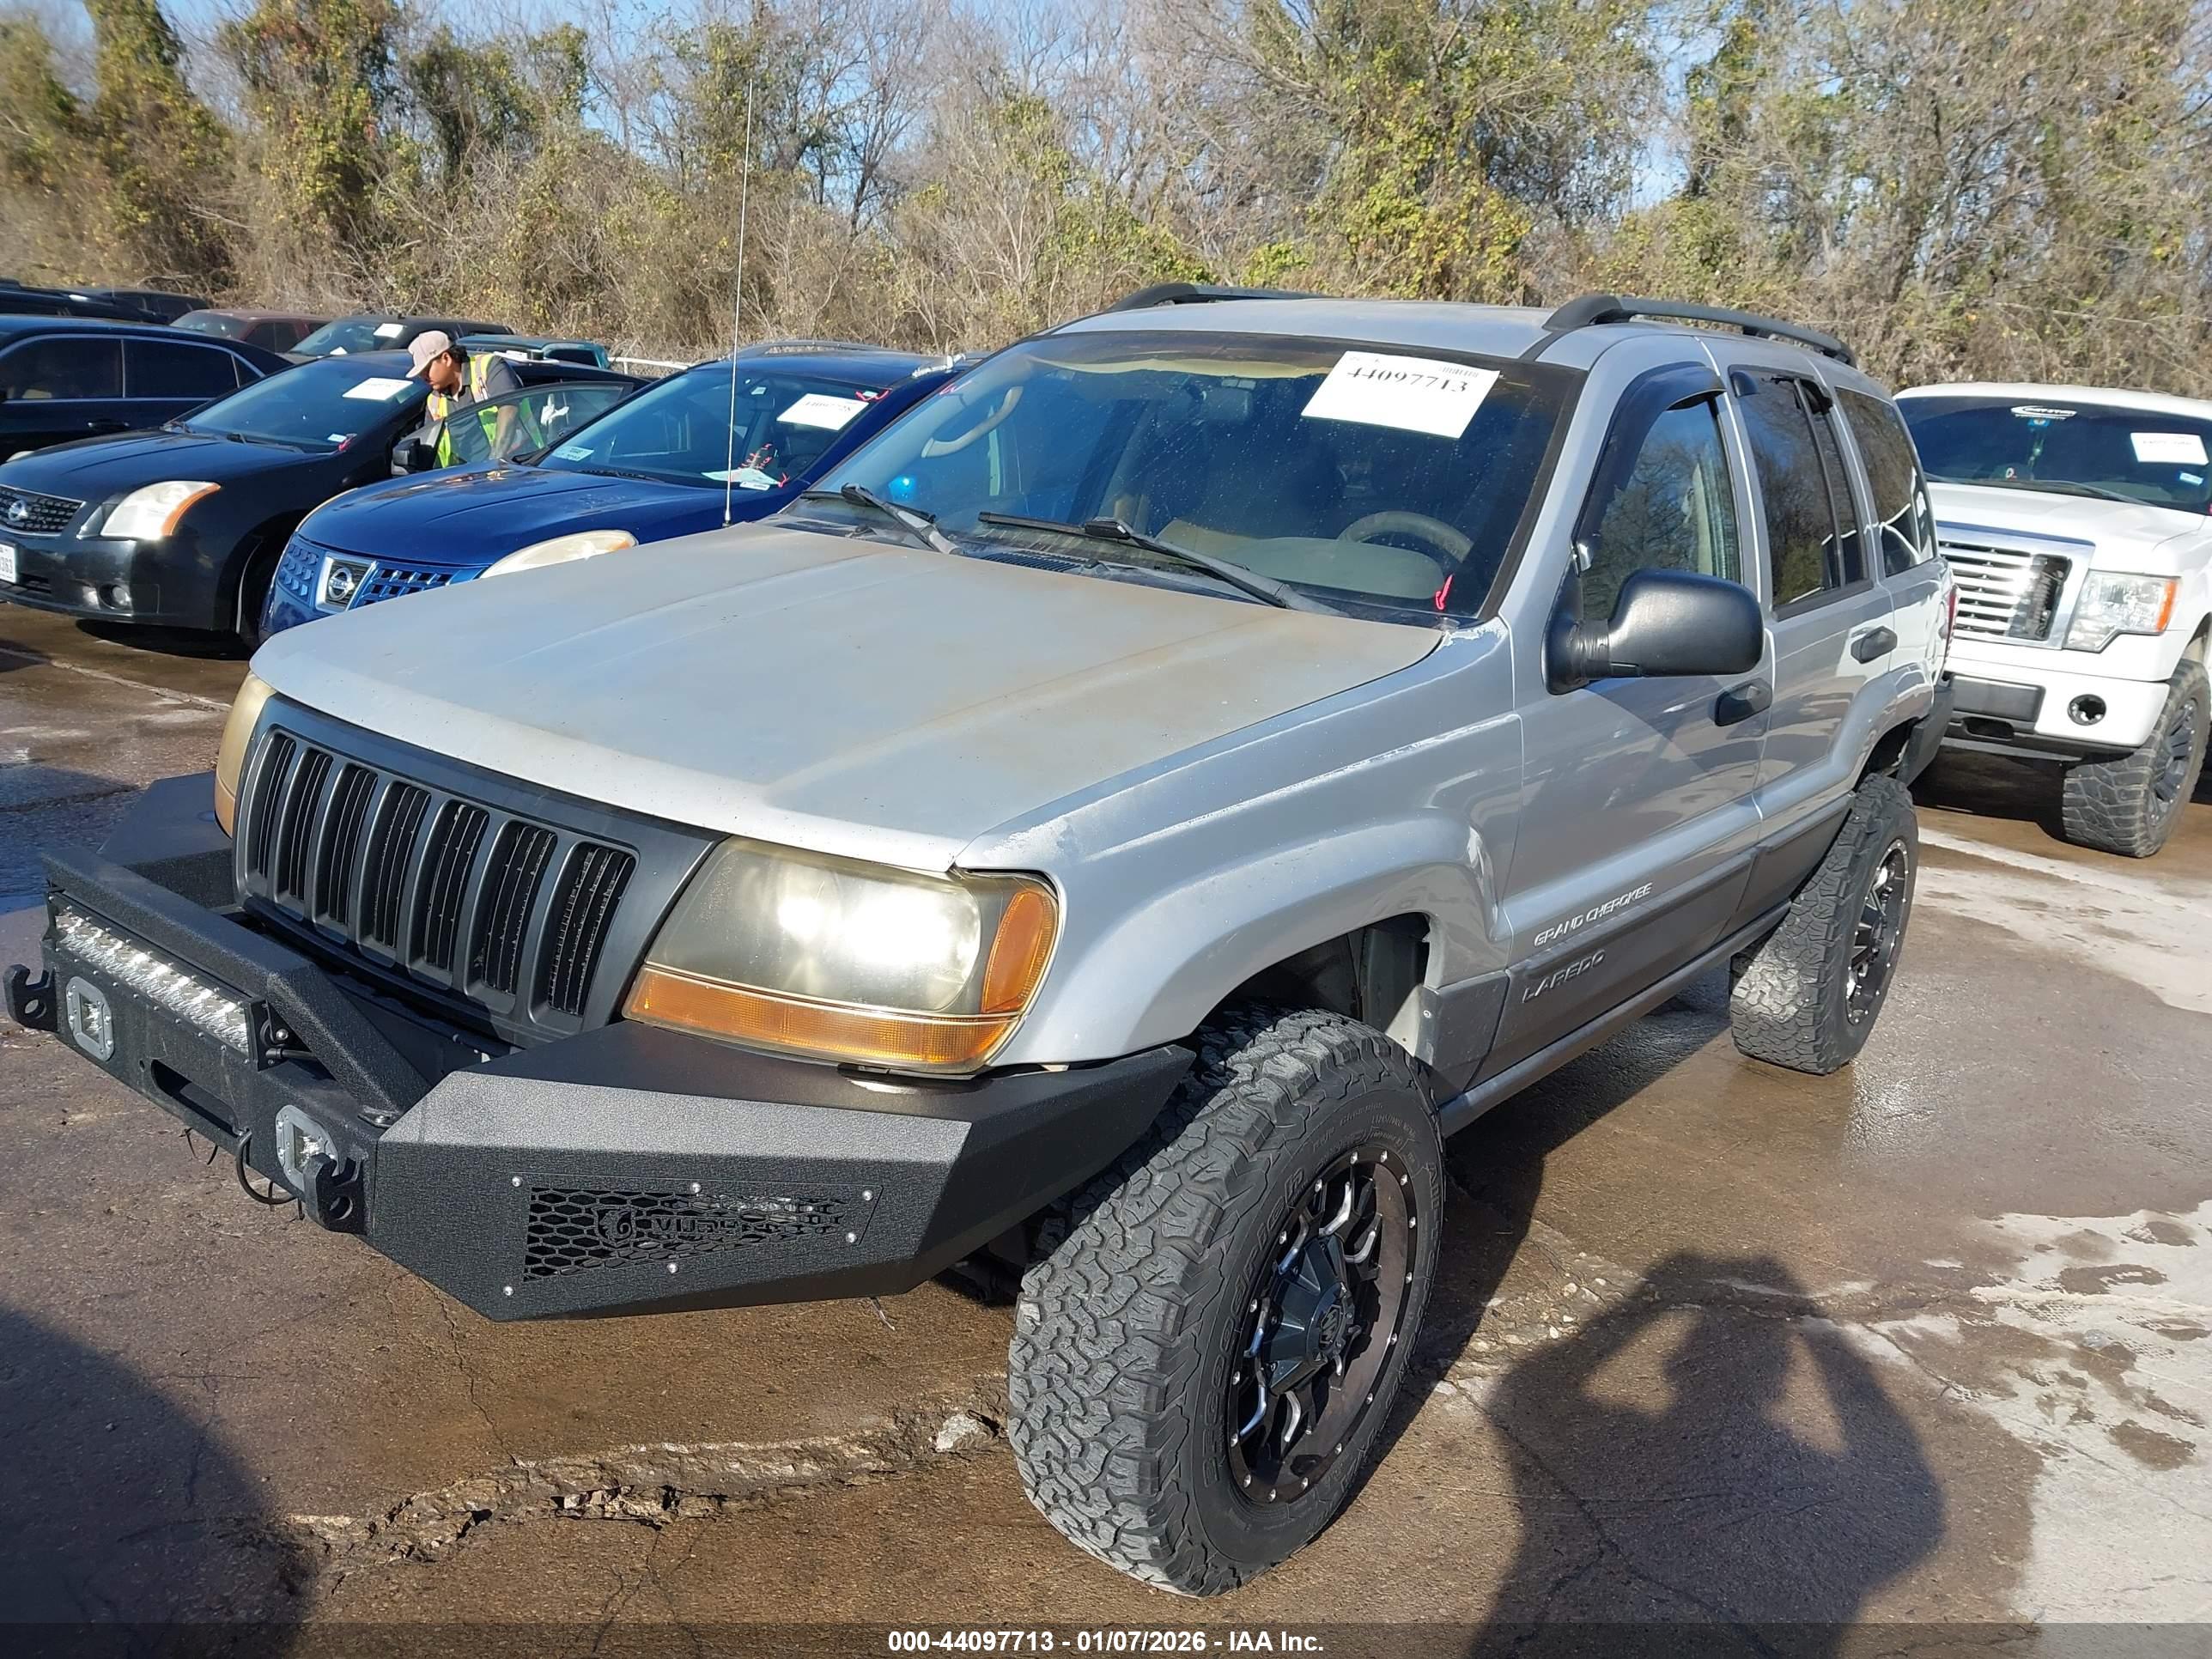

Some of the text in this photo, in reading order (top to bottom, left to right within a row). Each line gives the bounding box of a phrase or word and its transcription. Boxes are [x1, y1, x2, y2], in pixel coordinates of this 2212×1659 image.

[1347, 367, 1468, 392] 44097713
[1534, 882, 1653, 946] GRAND CHEROKEE
[1522, 948, 1607, 1004] LAREDO
